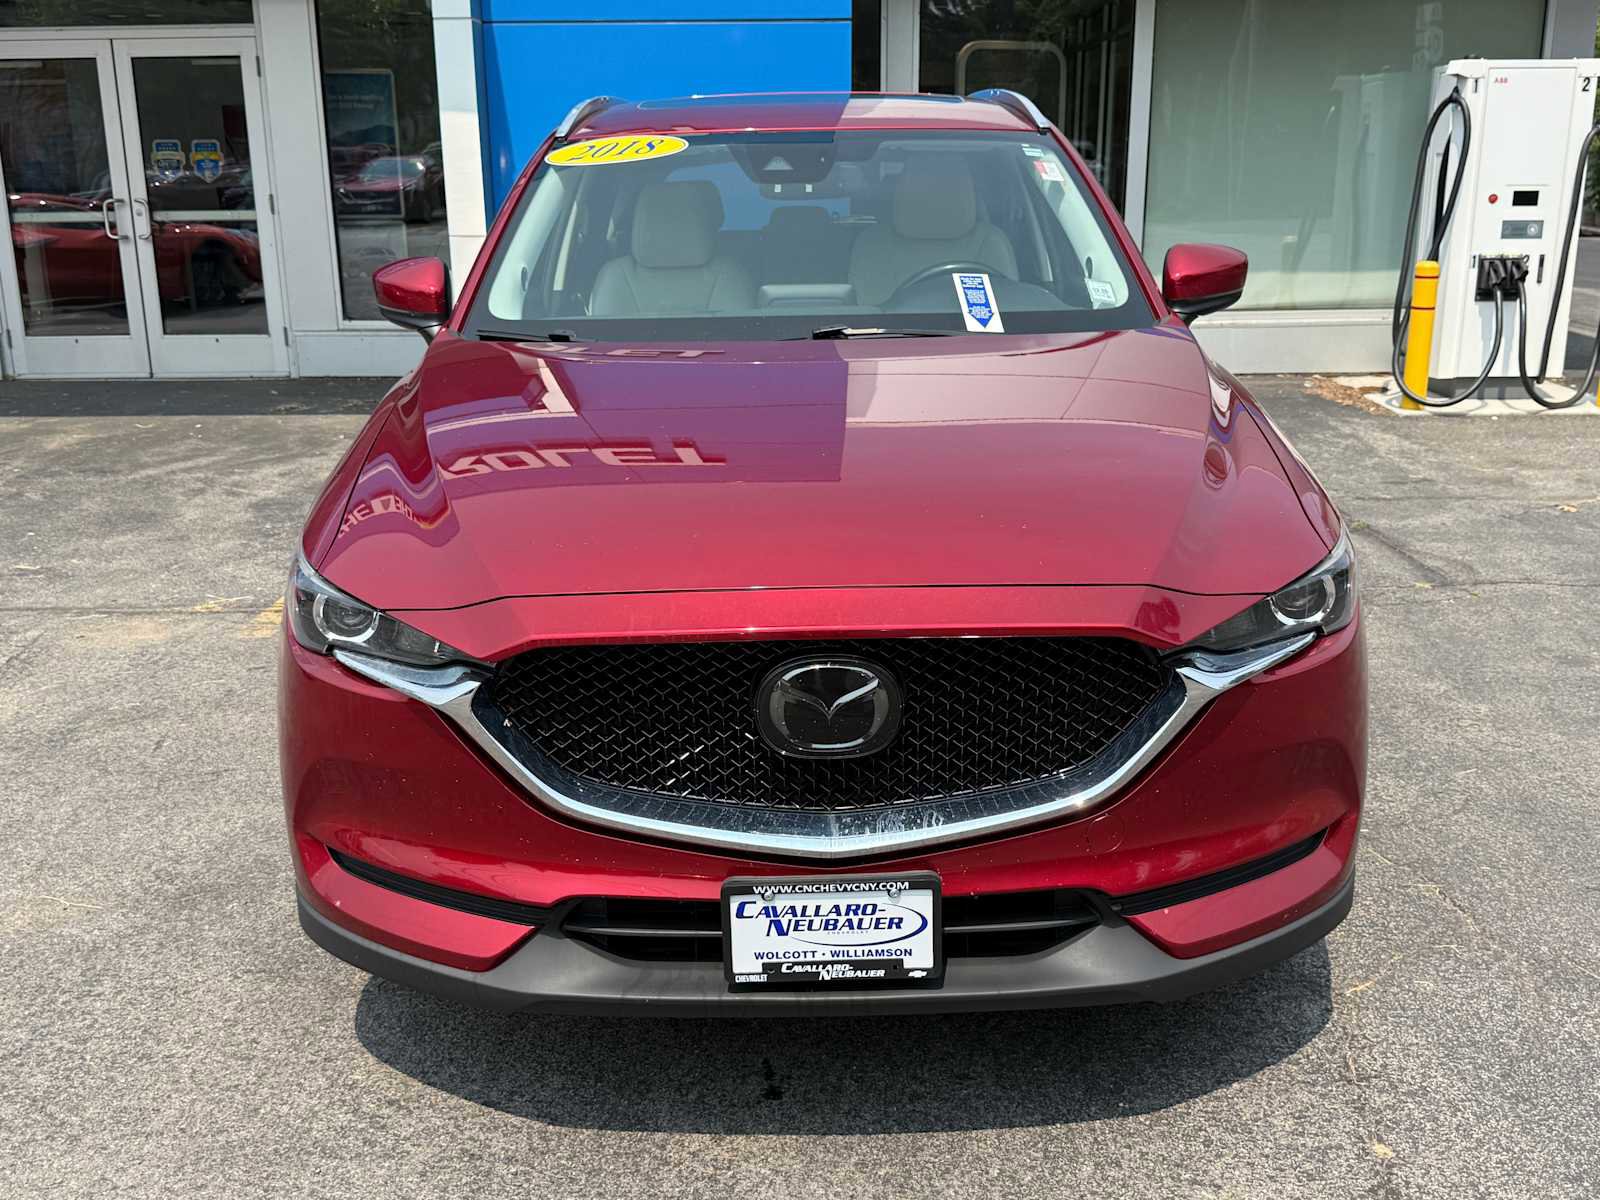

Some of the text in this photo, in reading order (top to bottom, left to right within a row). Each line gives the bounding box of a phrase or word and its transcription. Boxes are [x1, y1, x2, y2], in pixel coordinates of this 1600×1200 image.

[1581, 77, 1591, 92] 2
[565, 139, 664, 162] 2018
[753, 881, 909, 894] WWW.CNCHEVYCNY.COM
[735, 901, 886, 918] CAVALLARO-
[766, 917, 903, 937] NEUBAUER
[754, 948, 913, 960] WOLCOTT WILLIAMSON
[781, 963, 853, 974] CAVALLARO-
[818, 967, 885, 981] NEUBAUER
[735, 974, 768, 983] CHEVROLET
